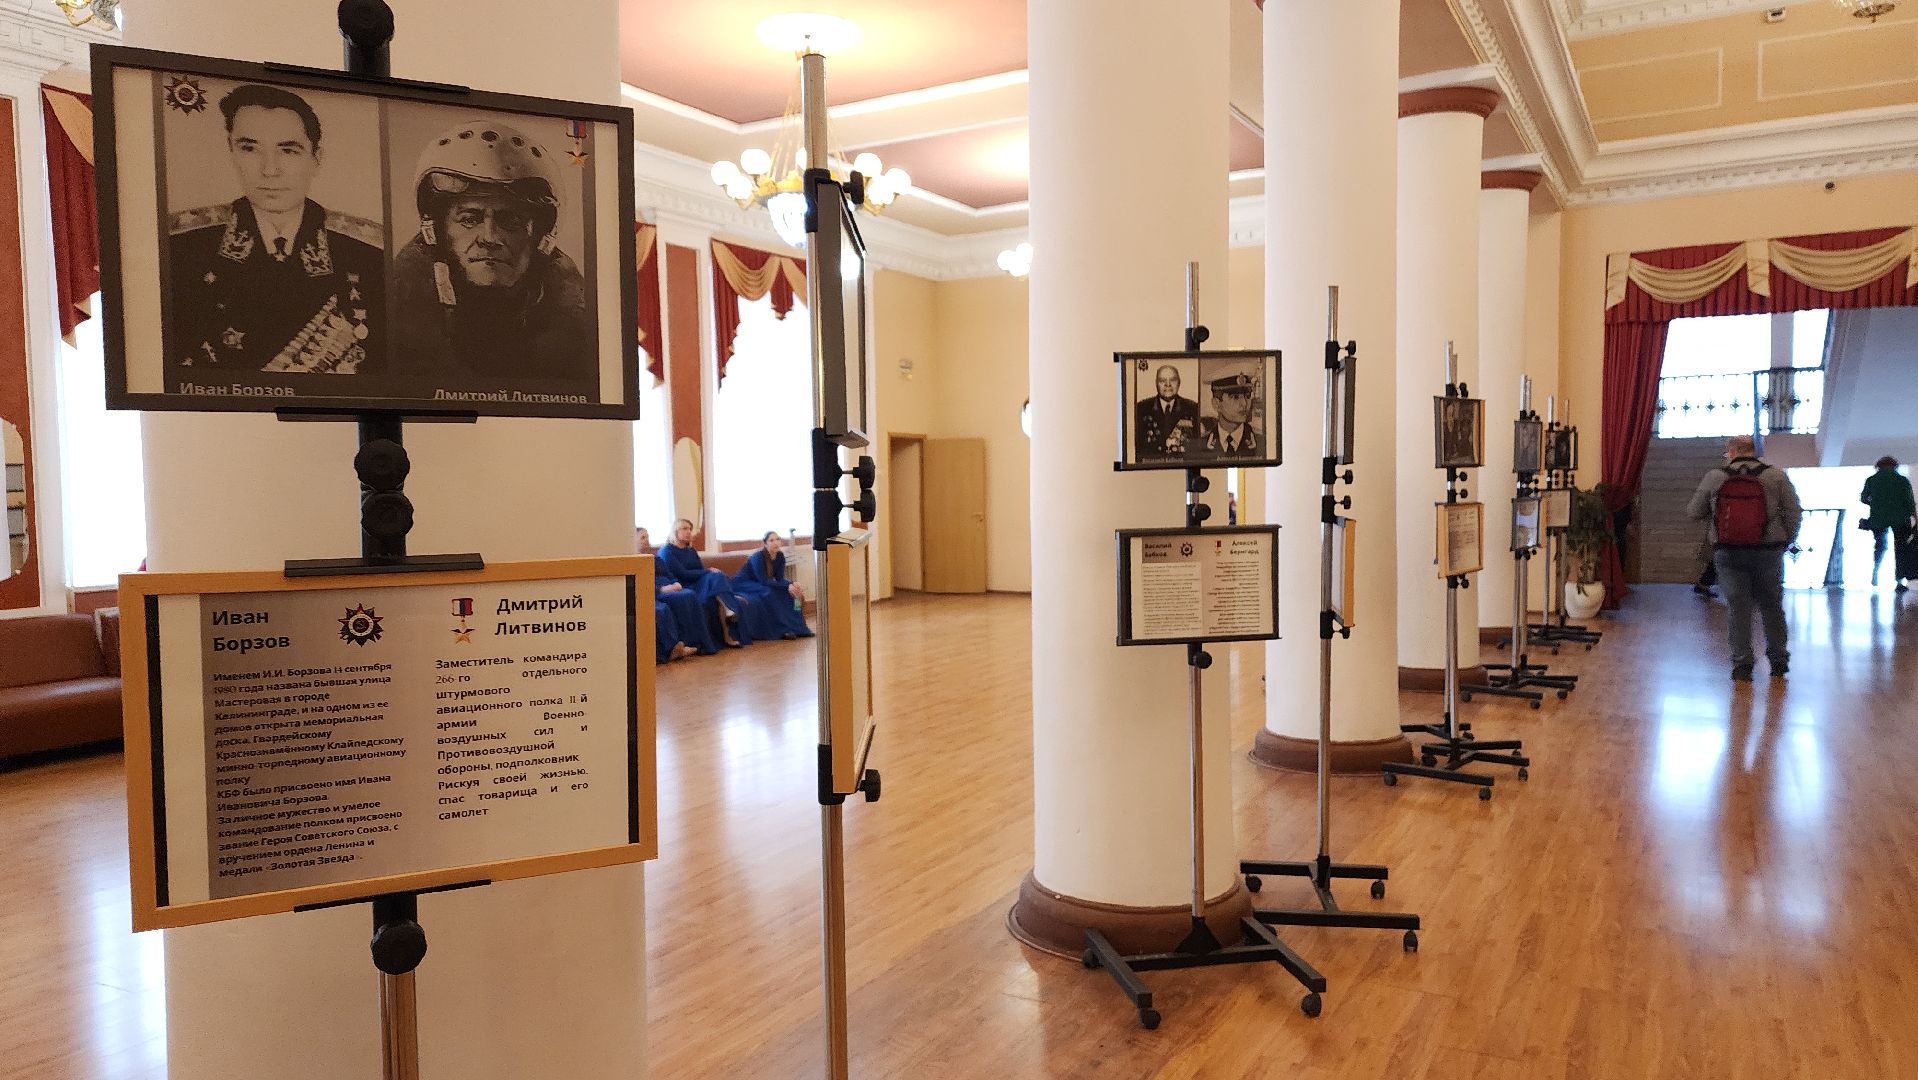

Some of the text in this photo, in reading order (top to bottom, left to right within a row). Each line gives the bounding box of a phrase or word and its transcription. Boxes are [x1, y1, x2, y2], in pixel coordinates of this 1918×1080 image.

[180, 382, 295, 396] Иван Борзов
[434, 389, 587, 403] Дмитрий Литвинов
[496, 595, 583, 615] Дмитрий
[212, 610, 269, 626] Иван
[494, 621, 587, 636] Литвинов
[213, 636, 290, 654] Борзов
[434, 652, 587, 669] Заместитель командира
[213, 672, 261, 681] Именем
[287, 667, 332, 678] Борзова
[344, 663, 392, 673] сентября
[522, 666, 588, 679] отдельного
[238, 685, 264, 694] года
[266, 681, 312, 691] названа
[313, 679, 357, 688] бывшая
[359, 676, 392, 686] улица
[436, 687, 511, 700] штурмового
[214, 692, 330, 707] Мастеровая в городе
[436, 701, 523, 715] авиационного
[529, 697, 563, 707] полка
[311, 705, 324, 714] на
[326, 703, 361, 713] одном
[214, 714, 384, 736] домов открыта мемориальная
[436, 719, 477, 731] армии
[253, 730, 332, 744] Гвардейскому
[437, 724, 588, 745] воздушных сил и
[216, 737, 405, 761] Краснознамённому Клайпедскому
[327, 749, 406, 761] авиационному
[437, 740, 555, 761] Противовоздушной
[495, 754, 580, 769] подполковник
[216, 776, 251, 786] полку
[216, 775, 391, 799] КБФ было присвоено имя Ивана
[438, 778, 480, 791] Рискуя
[493, 772, 527, 785] своей
[438, 782, 589, 805] спас товарища и его
[216, 799, 280, 811] Ивановича
[217, 816, 231, 825] За
[233, 812, 276, 823] личное
[277, 808, 331, 819] мужество
[342, 801, 381, 812] умелое
[438, 808, 489, 820] самолет
[218, 811, 402, 837] командование полком присвоено
[219, 840, 259, 851] звание
[261, 836, 293, 846] Героя
[294, 829, 355, 842] Советского
[218, 851, 282, 865] вручением
[283, 845, 323, 857] ордена
[325, 840, 365, 851] Ленина
[219, 866, 263, 878] медали
